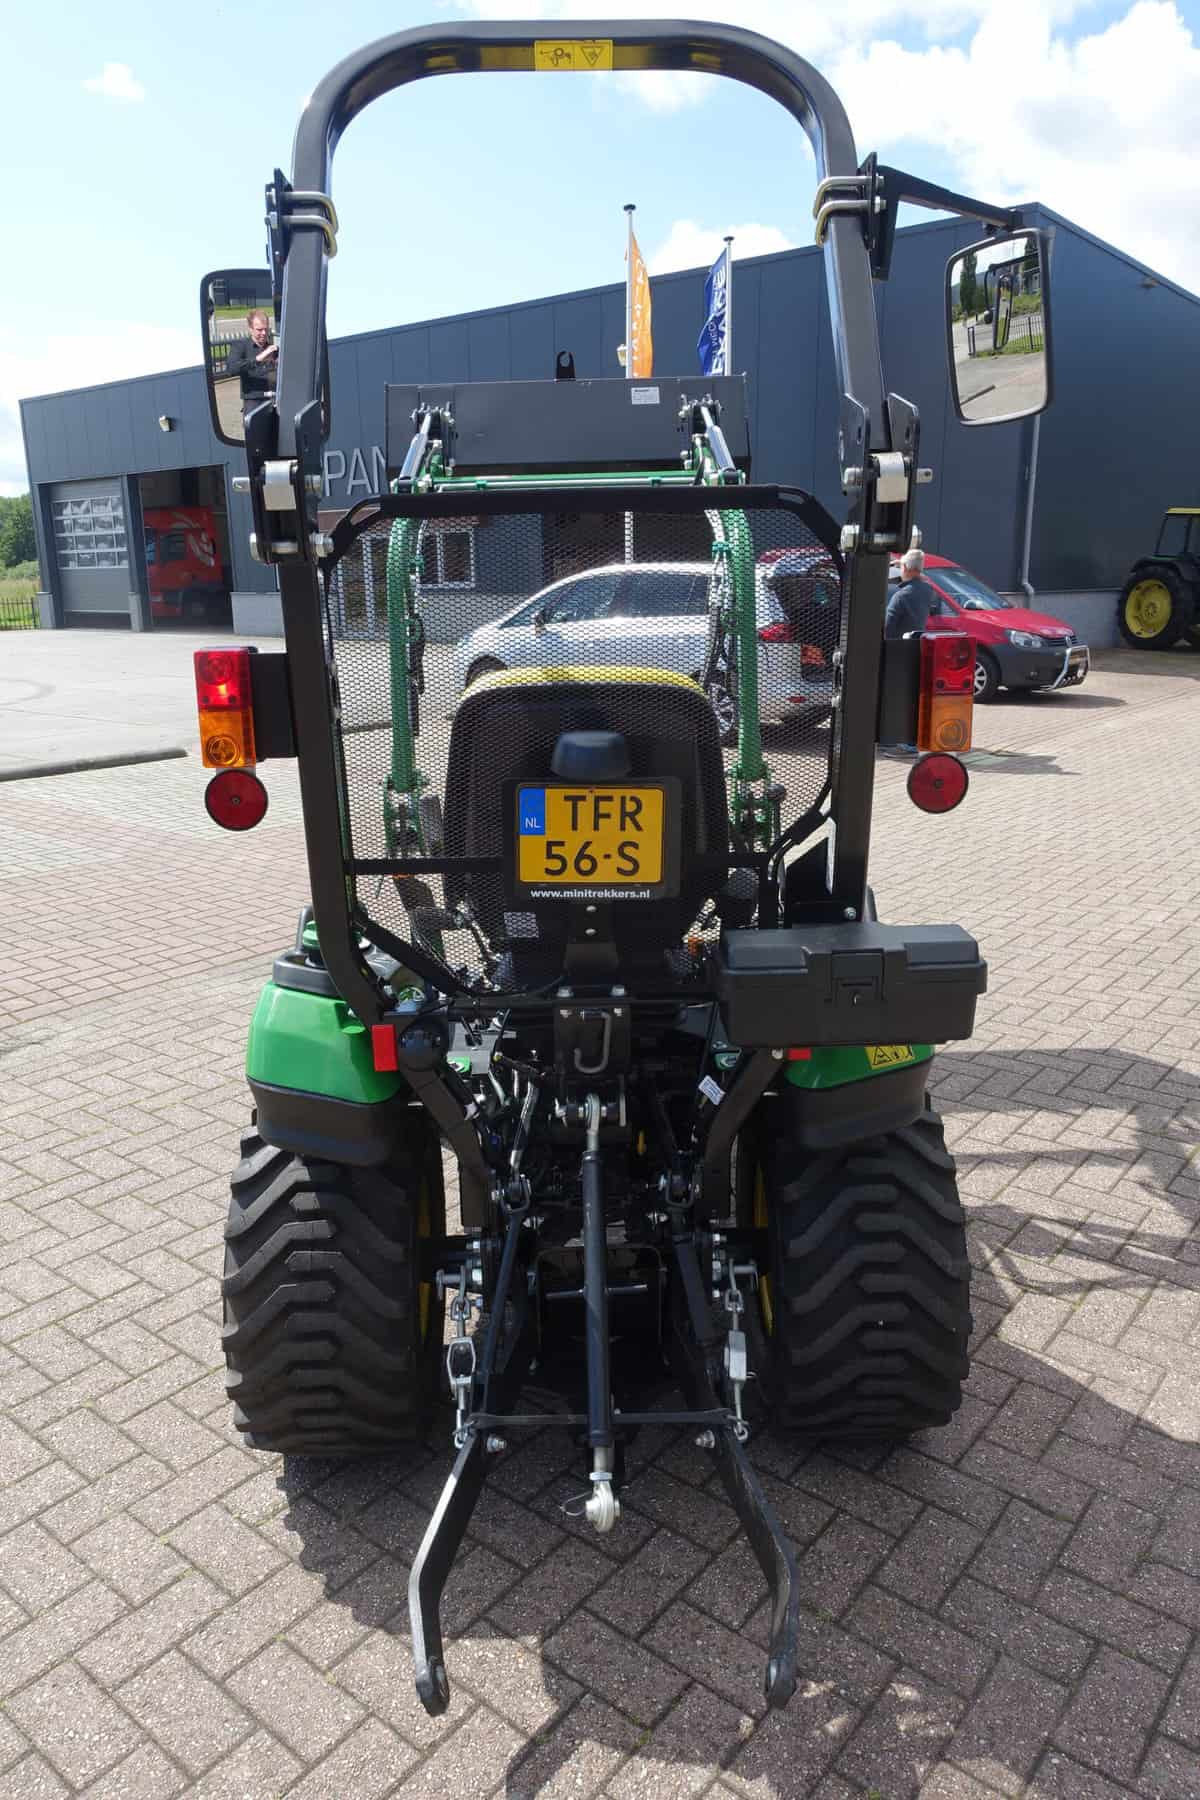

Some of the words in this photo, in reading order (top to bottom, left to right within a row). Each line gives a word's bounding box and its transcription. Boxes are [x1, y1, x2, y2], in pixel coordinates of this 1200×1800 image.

[525, 817, 542, 828] NL
[564, 795, 643, 831] TFR
[544, 840, 640, 876] 56-S
[530, 888, 650, 898] www.minitrekkers.nl
